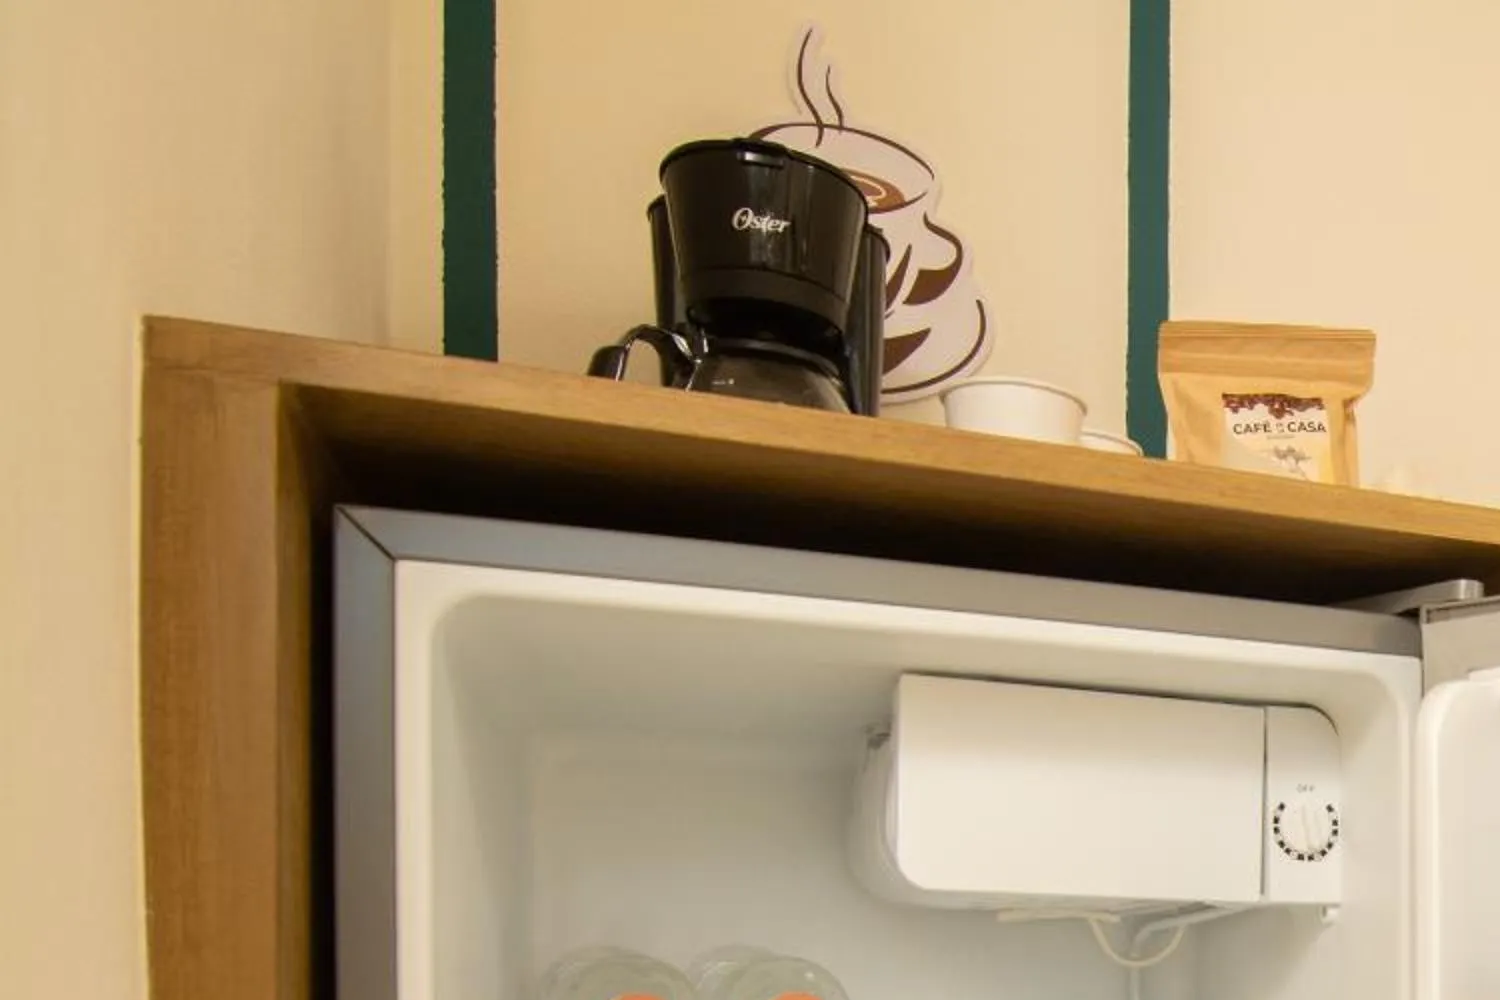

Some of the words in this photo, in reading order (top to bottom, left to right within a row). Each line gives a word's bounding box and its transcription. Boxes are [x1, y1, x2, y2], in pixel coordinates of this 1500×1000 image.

[732, 207, 792, 236] Oster
[1233, 420, 1272, 435] CAFÉ
[1287, 421, 1326, 433] CASA
